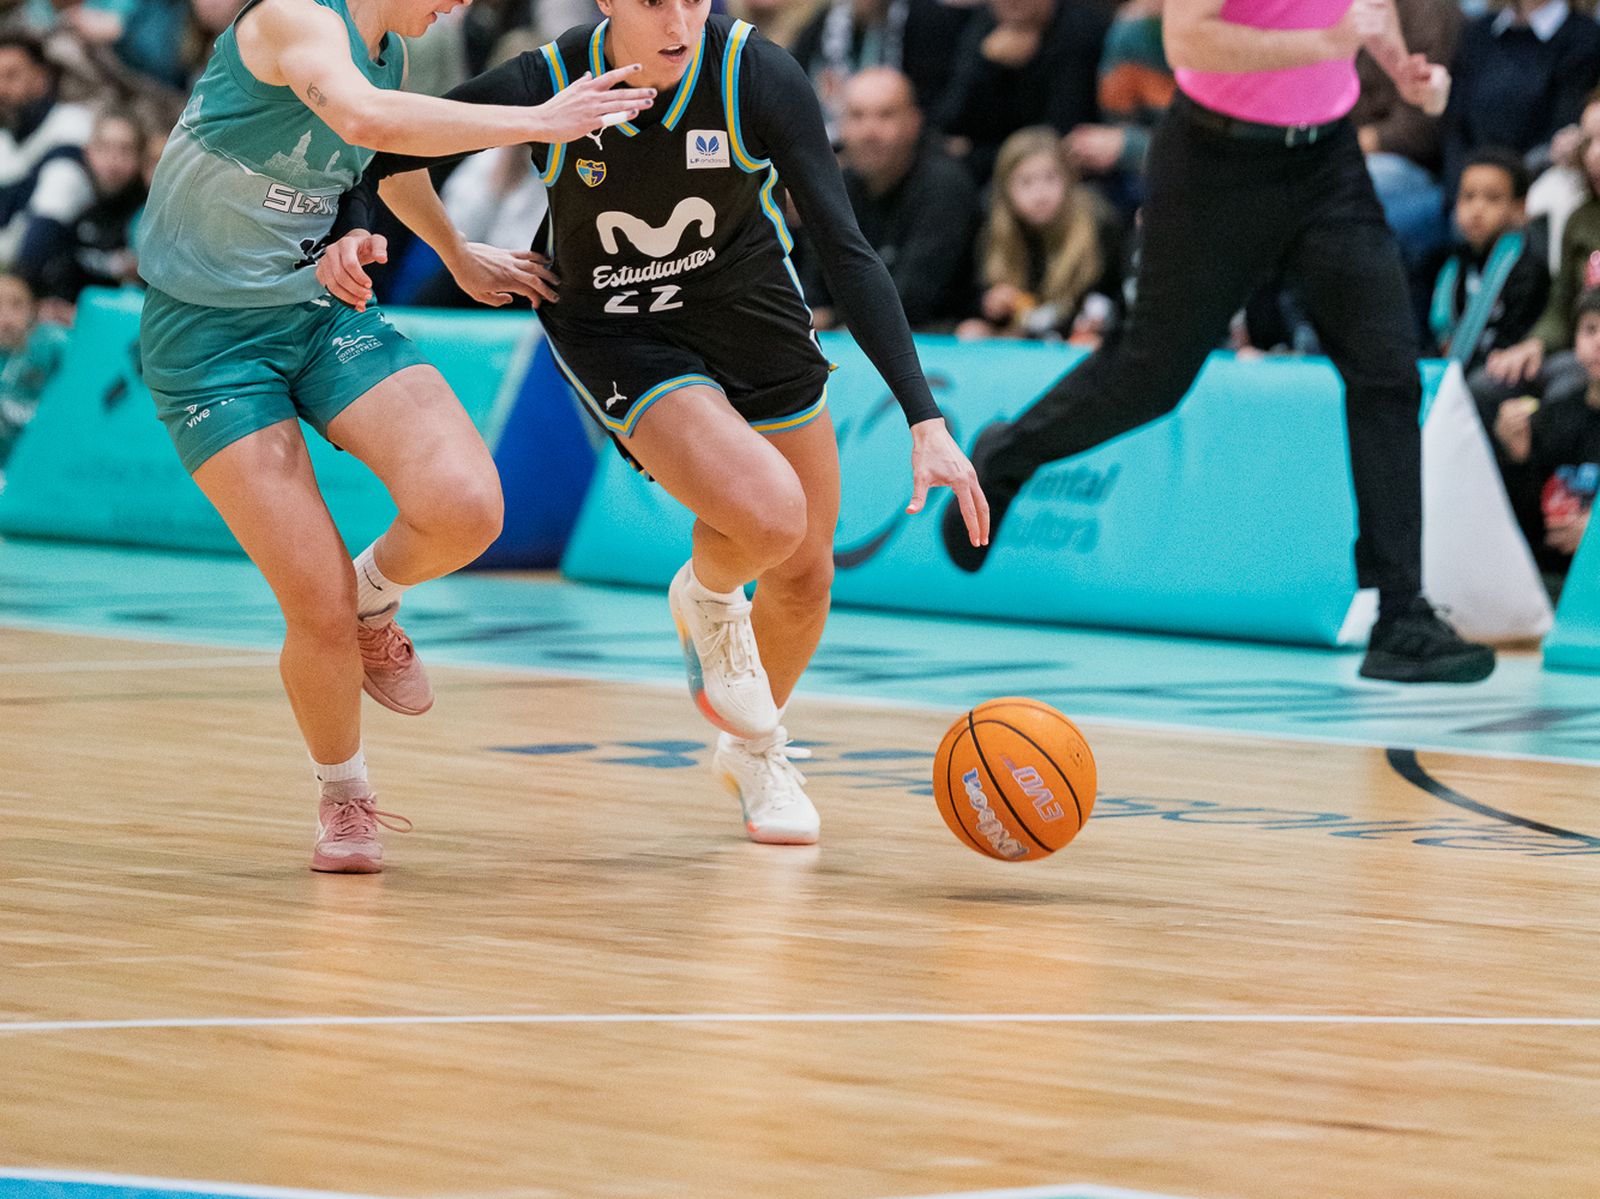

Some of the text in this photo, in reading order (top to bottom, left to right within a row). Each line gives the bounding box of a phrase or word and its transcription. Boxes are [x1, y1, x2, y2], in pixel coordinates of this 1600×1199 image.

[593, 247, 716, 289] Estudiantes
[186, 408, 210, 428] vive
[1012, 766, 1065, 822] EVO
